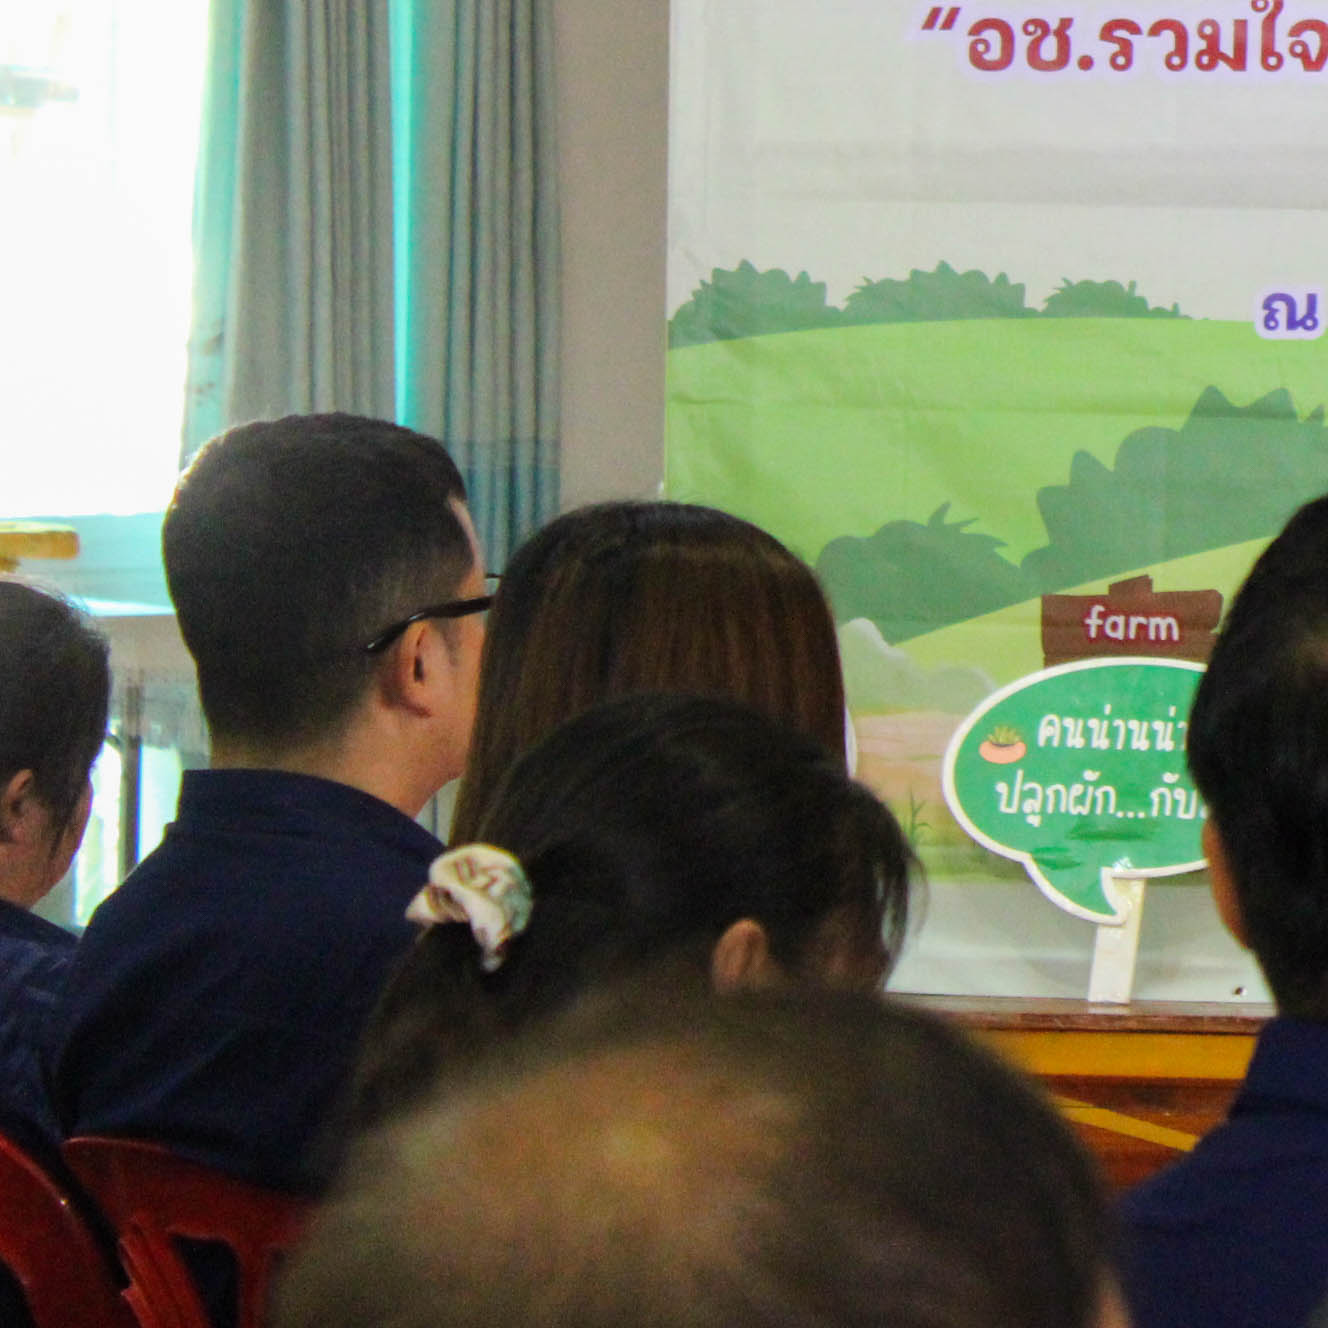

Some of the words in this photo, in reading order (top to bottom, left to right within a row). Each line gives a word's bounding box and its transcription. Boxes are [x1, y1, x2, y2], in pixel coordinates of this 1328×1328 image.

[1261, 291, 1320, 333] ณ
[1083, 605, 1181, 642] farm
[1036, 703, 1189, 753] คนน่านน่า
